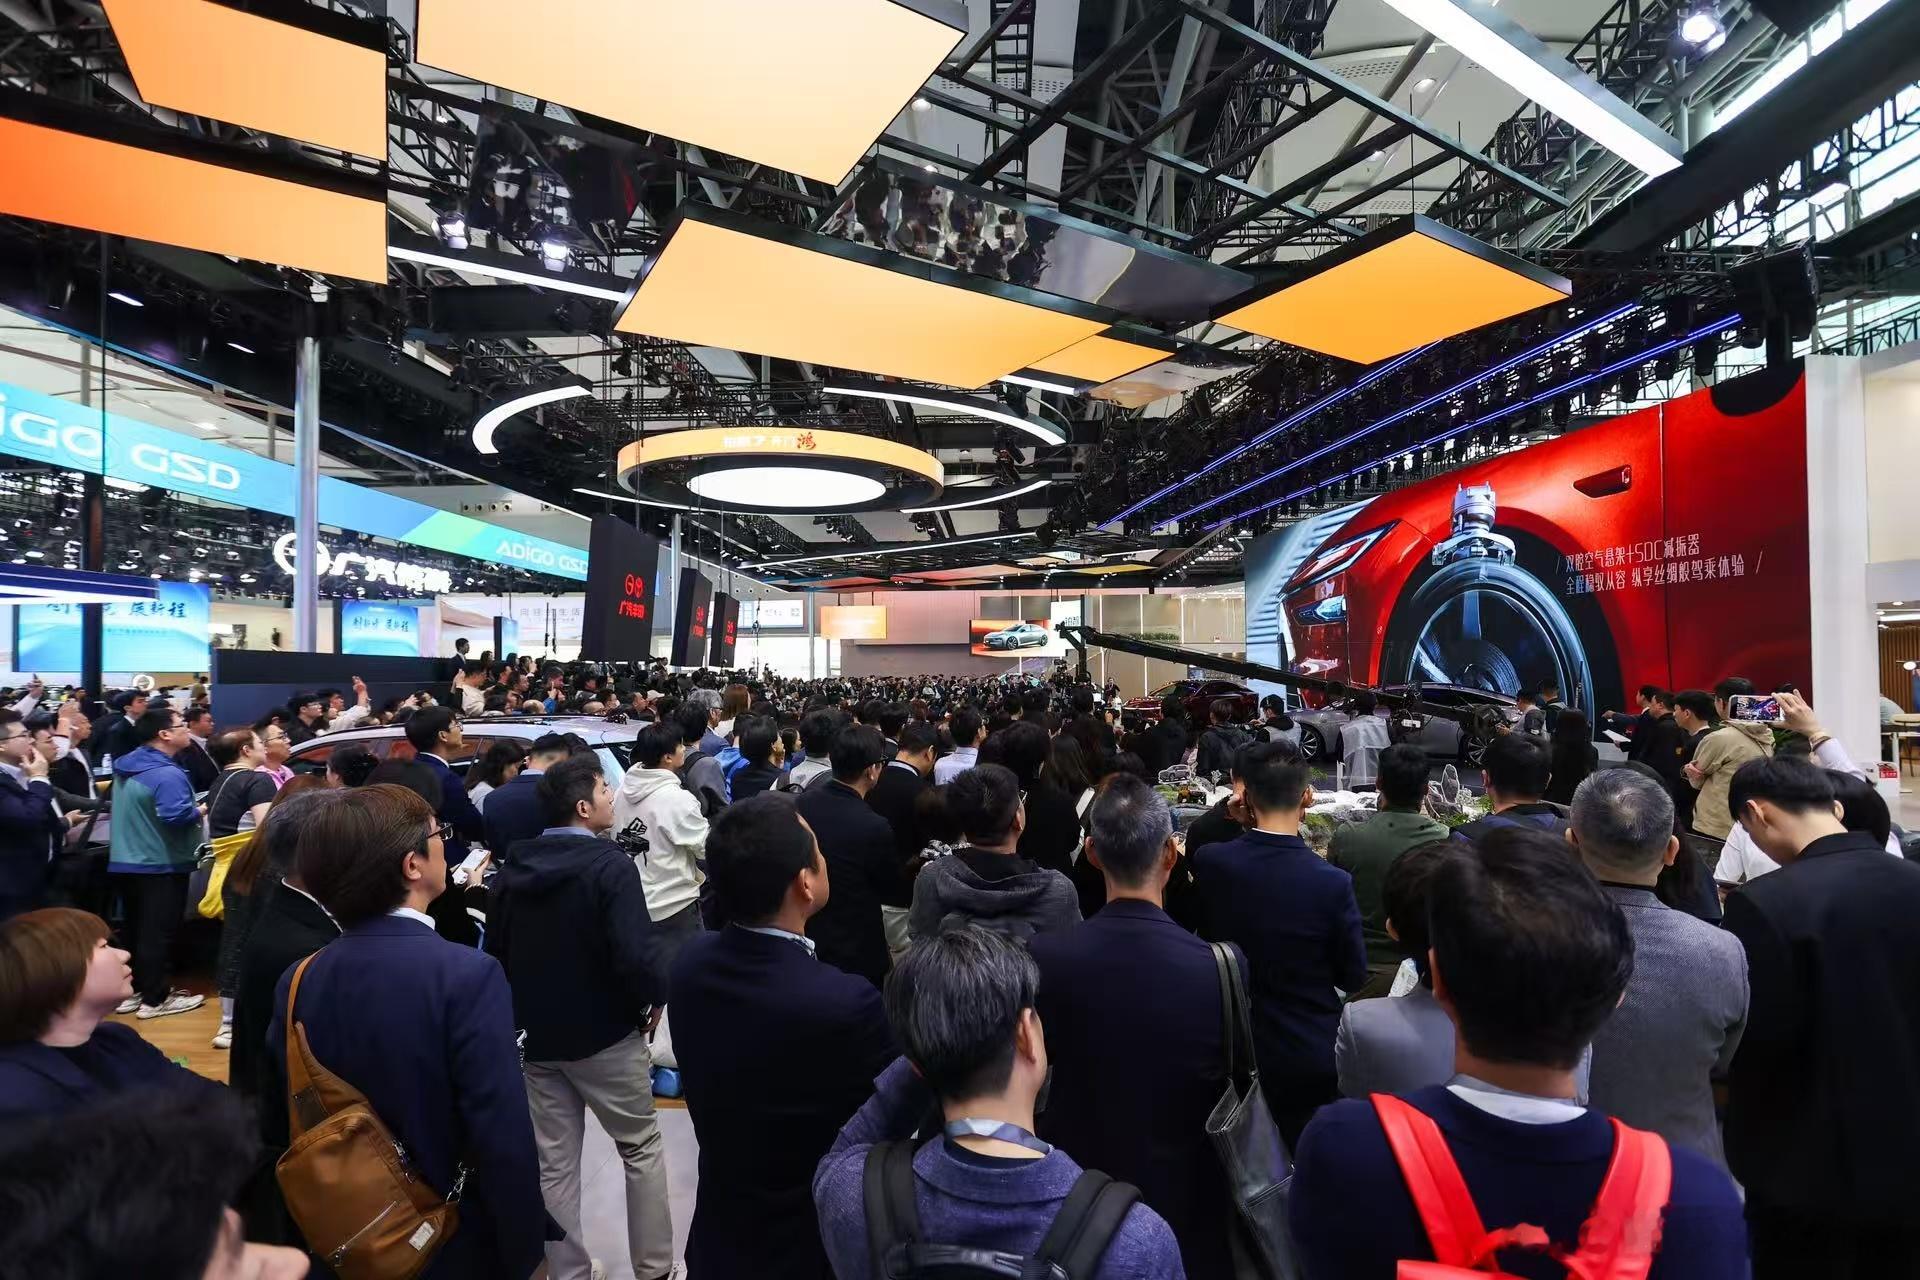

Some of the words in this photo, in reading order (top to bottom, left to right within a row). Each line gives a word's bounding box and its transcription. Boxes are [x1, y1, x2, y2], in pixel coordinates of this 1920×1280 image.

[130, 442, 241, 491] GSD
[1565, 533, 1700, 573] 双腔空气悬架+SDC减振器
[1631, 553, 1745, 588] 纵享丝绸般驾乘体验
